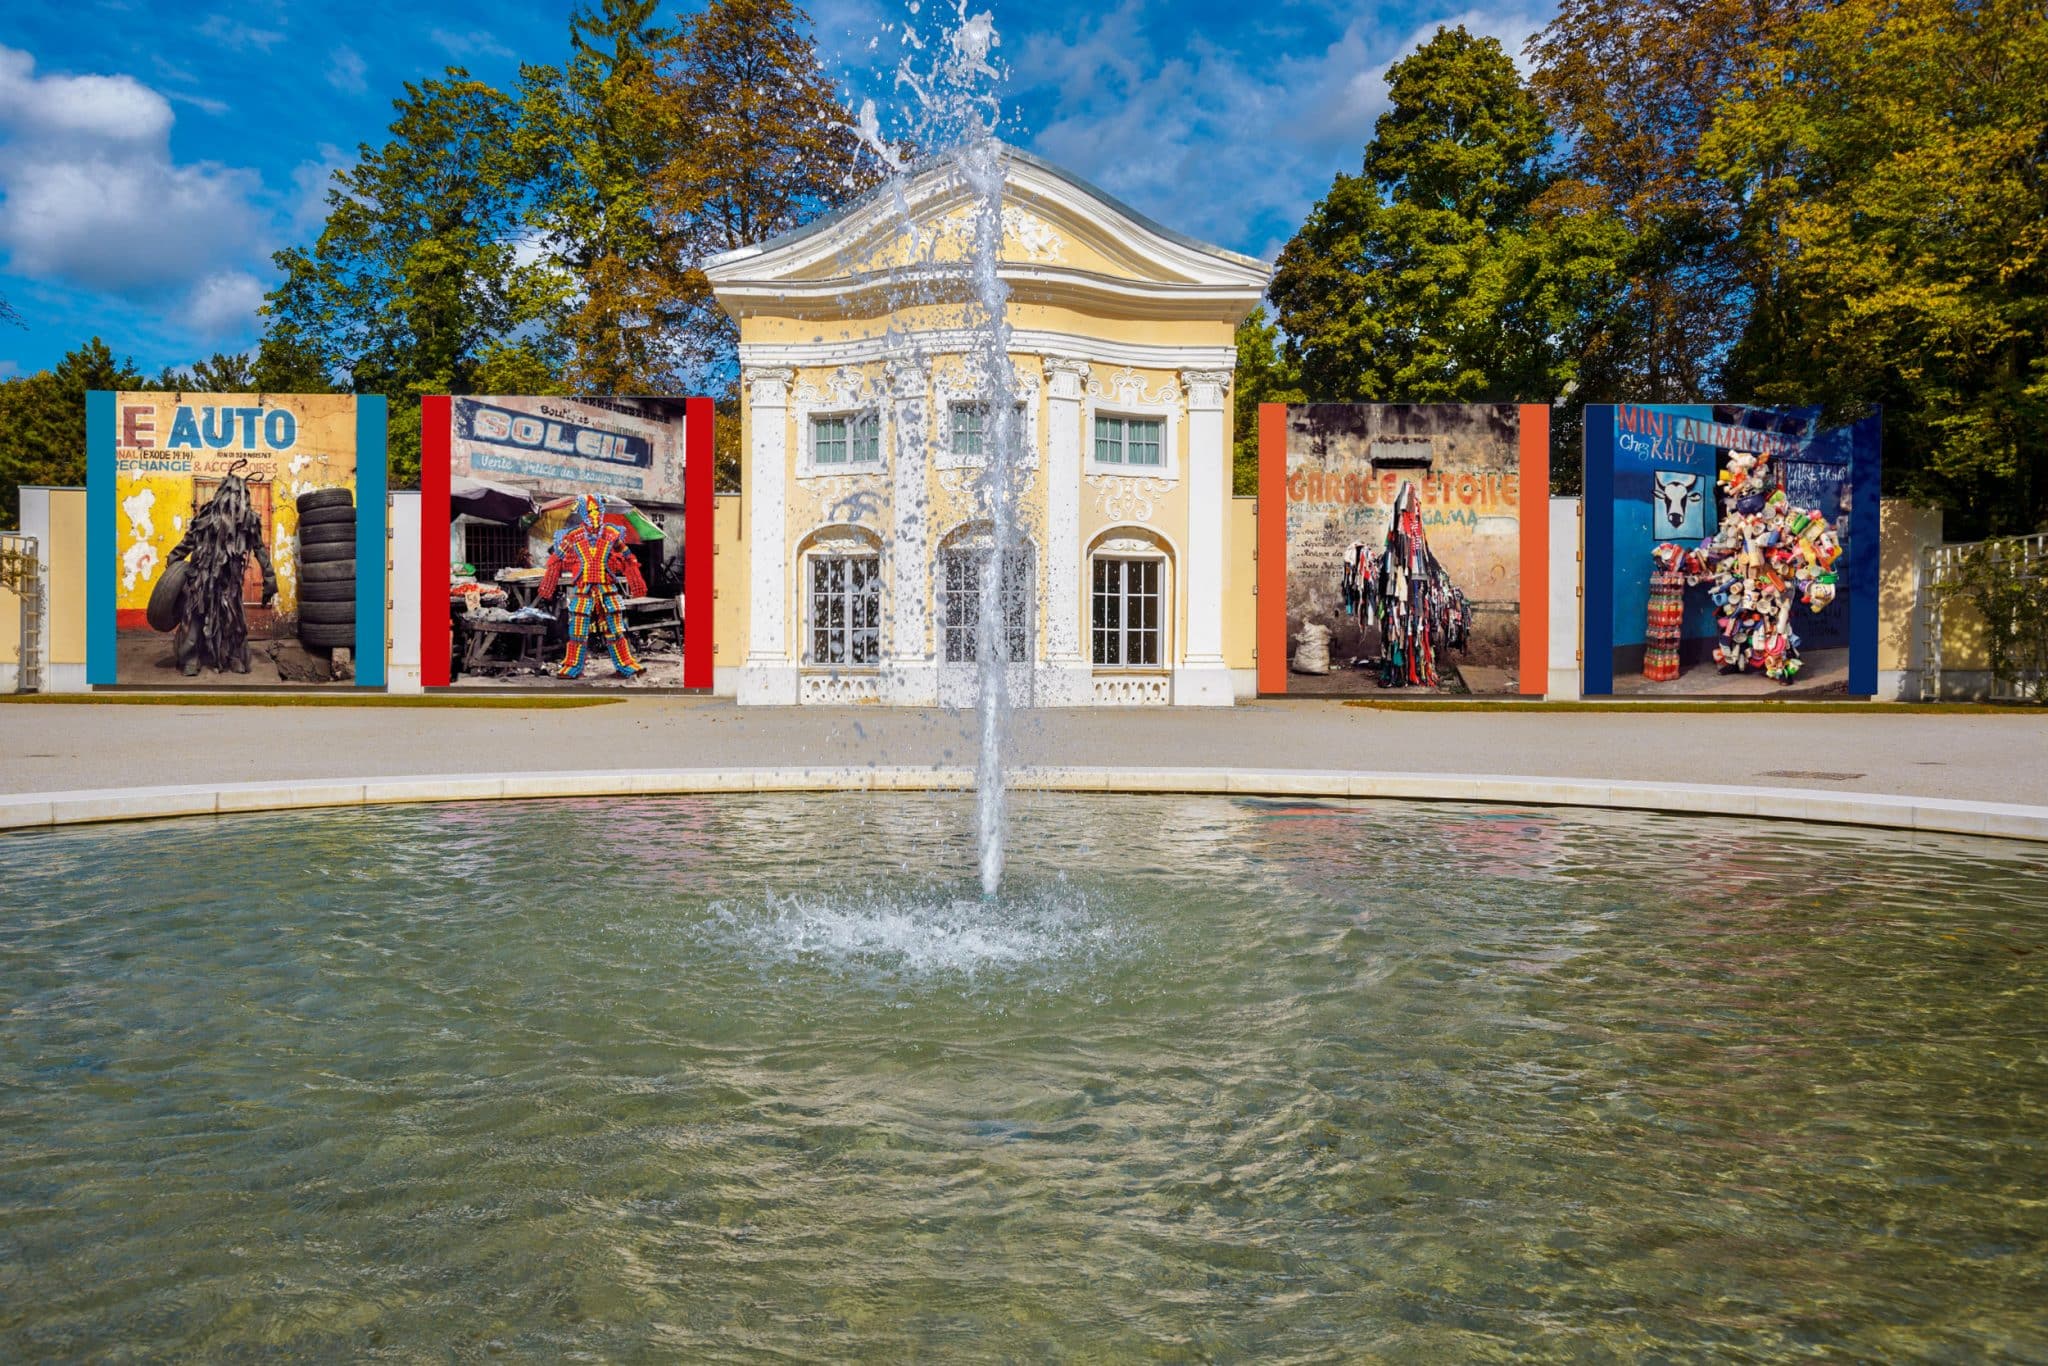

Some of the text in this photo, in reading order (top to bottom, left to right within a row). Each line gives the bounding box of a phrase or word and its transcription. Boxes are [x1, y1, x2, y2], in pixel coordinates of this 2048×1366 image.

[167, 406, 296, 449] AUTO
[474, 408, 637, 463] SOLEIL
[1618, 403, 1673, 438] MINI
[1619, 434, 1696, 464] Chez KATY
[194, 461, 201, 473] &
[1288, 472, 1519, 506] GARAGE ETOILE
